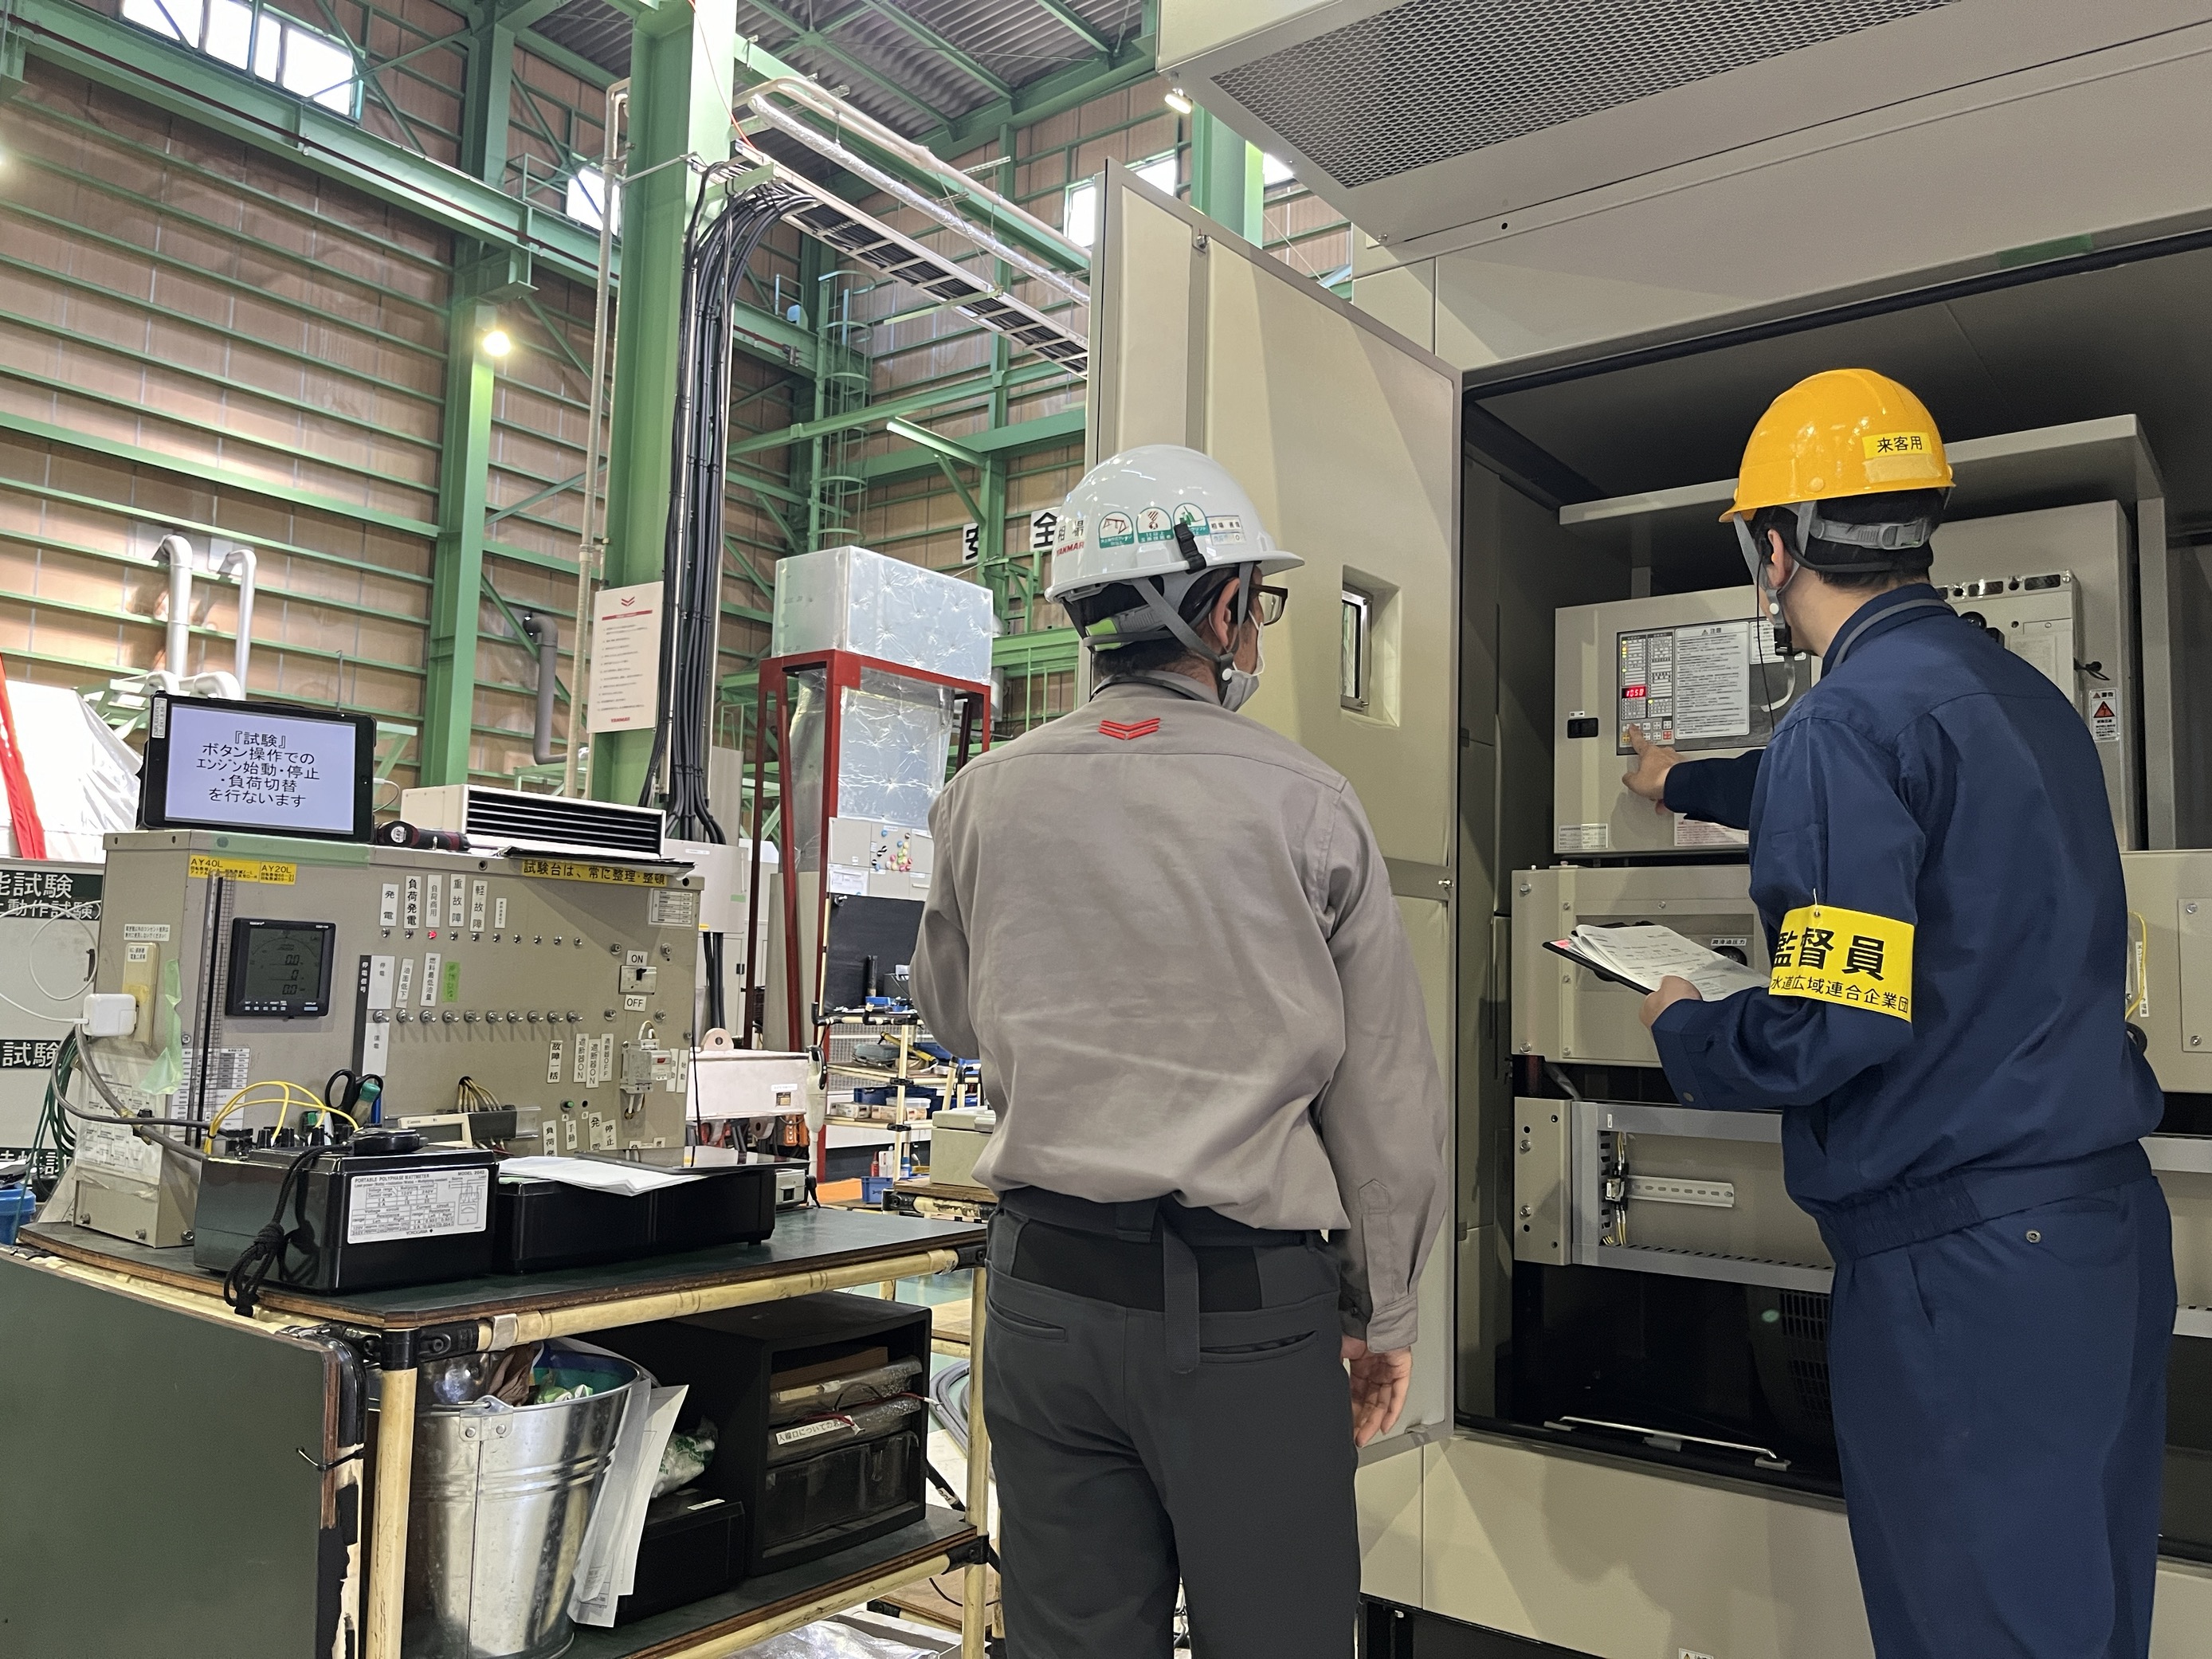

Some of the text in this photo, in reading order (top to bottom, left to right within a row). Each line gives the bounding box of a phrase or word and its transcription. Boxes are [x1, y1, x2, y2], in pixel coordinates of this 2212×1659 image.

[1877, 436, 1923, 453] 来客用
[1057, 542, 1084, 555] YANMAR
[234, 731, 286, 748] 『試験』
[202, 743, 315, 765] ボタン操作での
[221, 776, 297, 793] ・負荷切替
[209, 788, 306, 807] を行ないます
[190, 859, 223, 868] AY40L
[261, 865, 292, 873] AY20L
[524, 860, 665, 885] 試験台は、常に整理・整頓
[383, 890, 394, 920] 発電
[407, 878, 418, 926] 負荷発電
[452, 879, 462, 924] 重故障
[473, 885, 484, 929] 軽故障
[631, 955, 643, 963] ON
[1774, 927, 1885, 982] 監督員
[626, 998, 643, 1007] OFF
[1771, 975, 1908, 1014] 水道広域連合企業団
[549, 1043, 561, 1080] 故障一括
[568, 1124, 575, 1143] 手動
